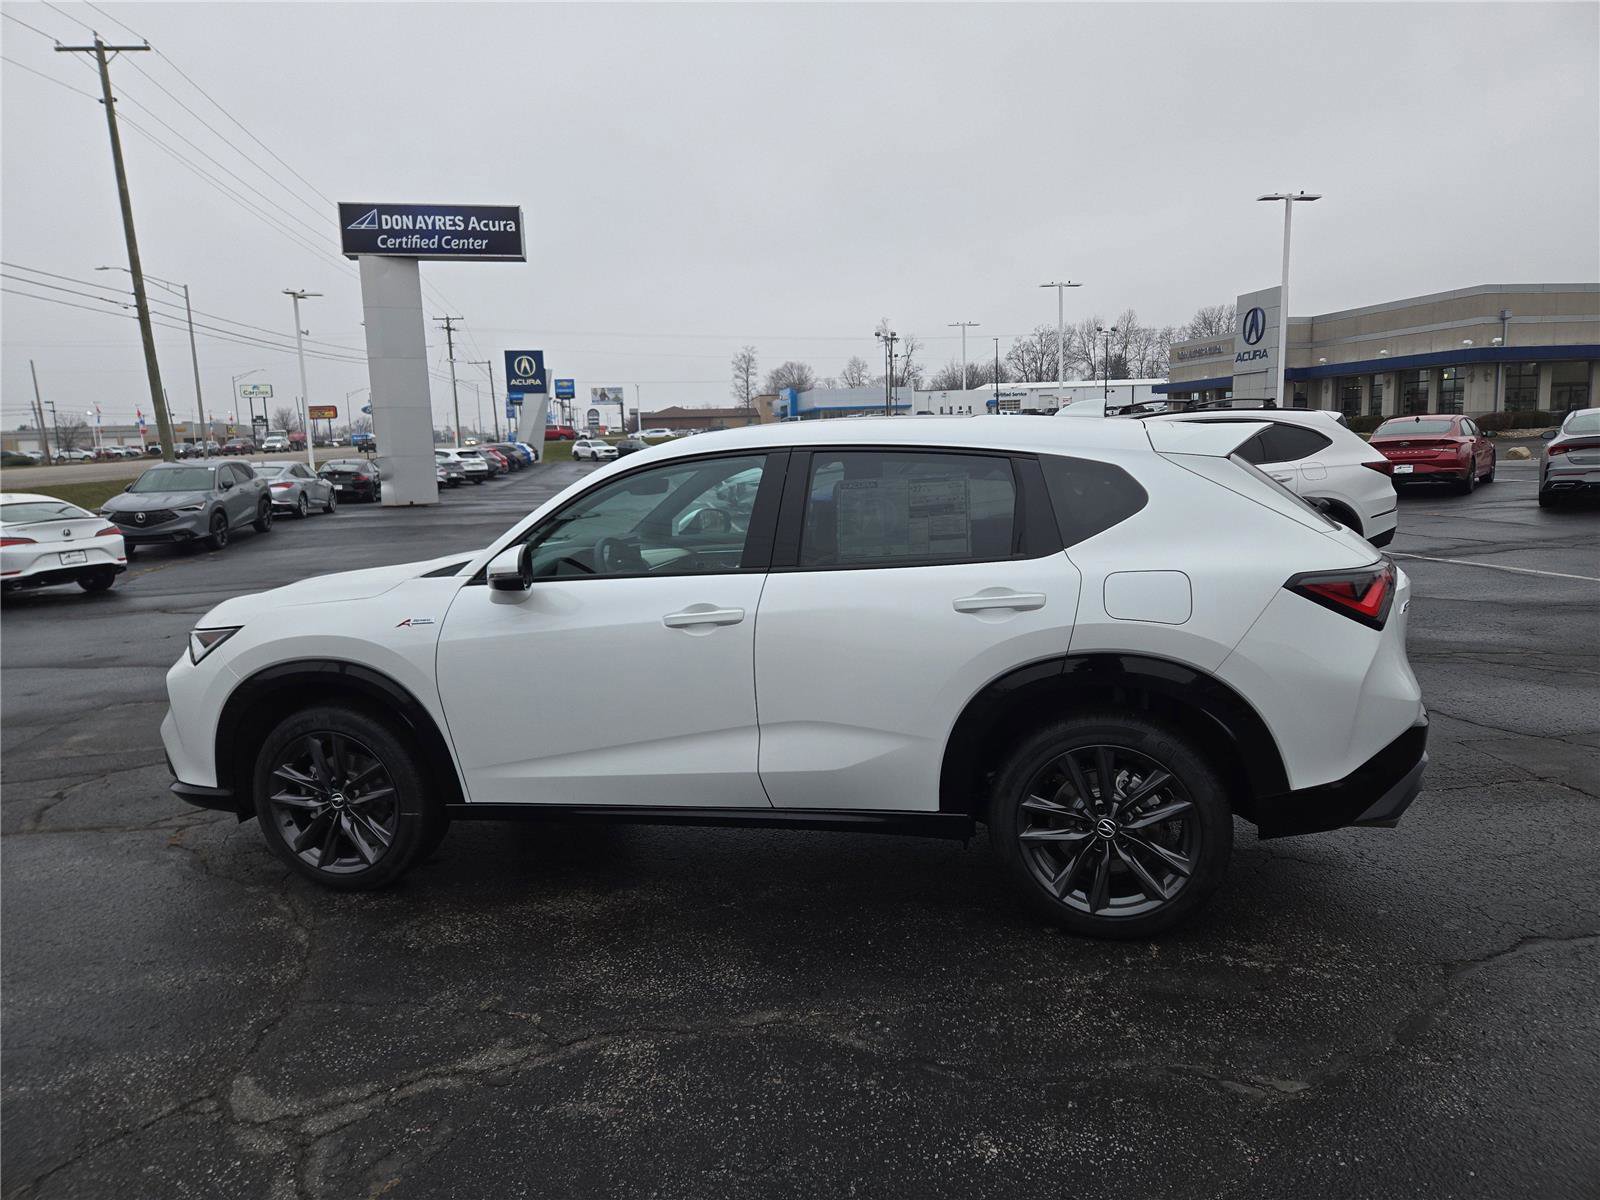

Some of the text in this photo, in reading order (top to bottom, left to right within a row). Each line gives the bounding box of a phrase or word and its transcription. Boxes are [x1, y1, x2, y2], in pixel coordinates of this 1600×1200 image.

[381, 214, 516, 232] DON AYRES Acura
[376, 234, 489, 250] Certified Center
[1235, 349, 1269, 363] ACURA
[510, 378, 542, 386] ACURA
